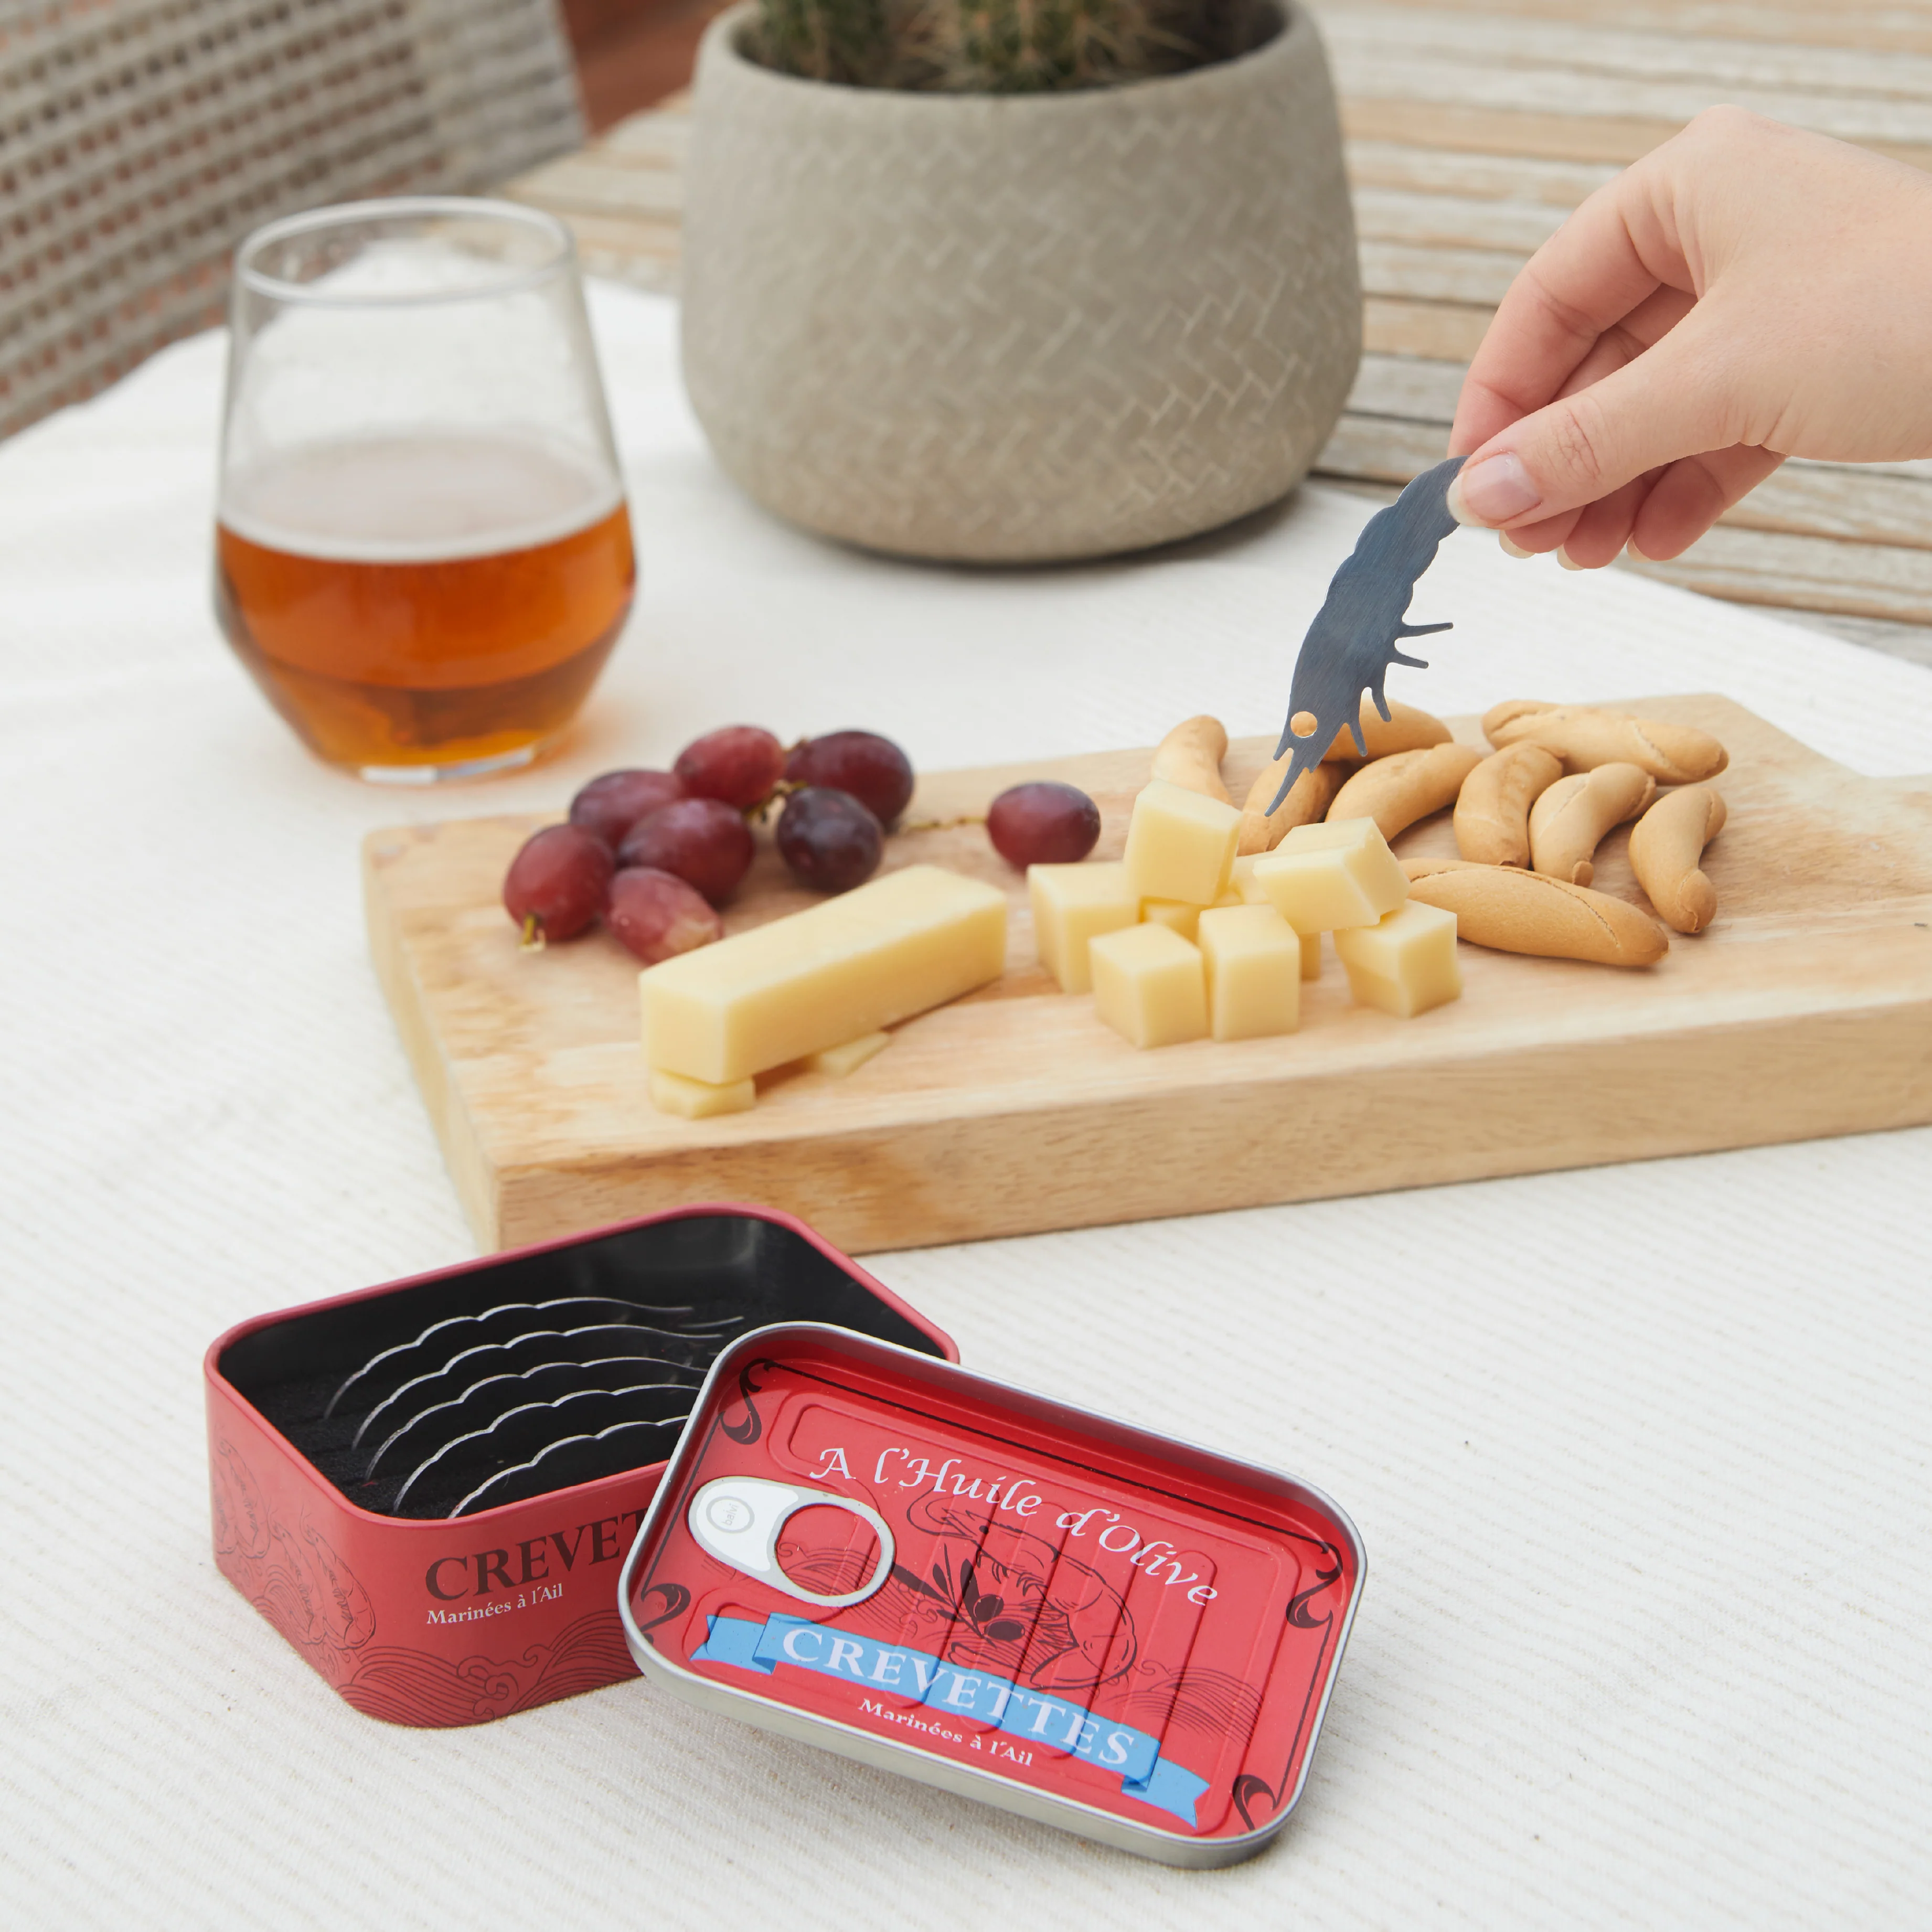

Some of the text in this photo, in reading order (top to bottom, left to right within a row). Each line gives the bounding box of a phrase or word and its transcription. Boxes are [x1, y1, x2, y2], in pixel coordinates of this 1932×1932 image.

[808, 1447, 857, 1480] A
[426, 1602, 511, 1625] Marinées
[517, 1594, 527, 1608] à
[782, 1628, 1135, 1765] CREVETTES
[857, 1698, 963, 1743] Marinées
[969, 1734, 982, 1750] à
